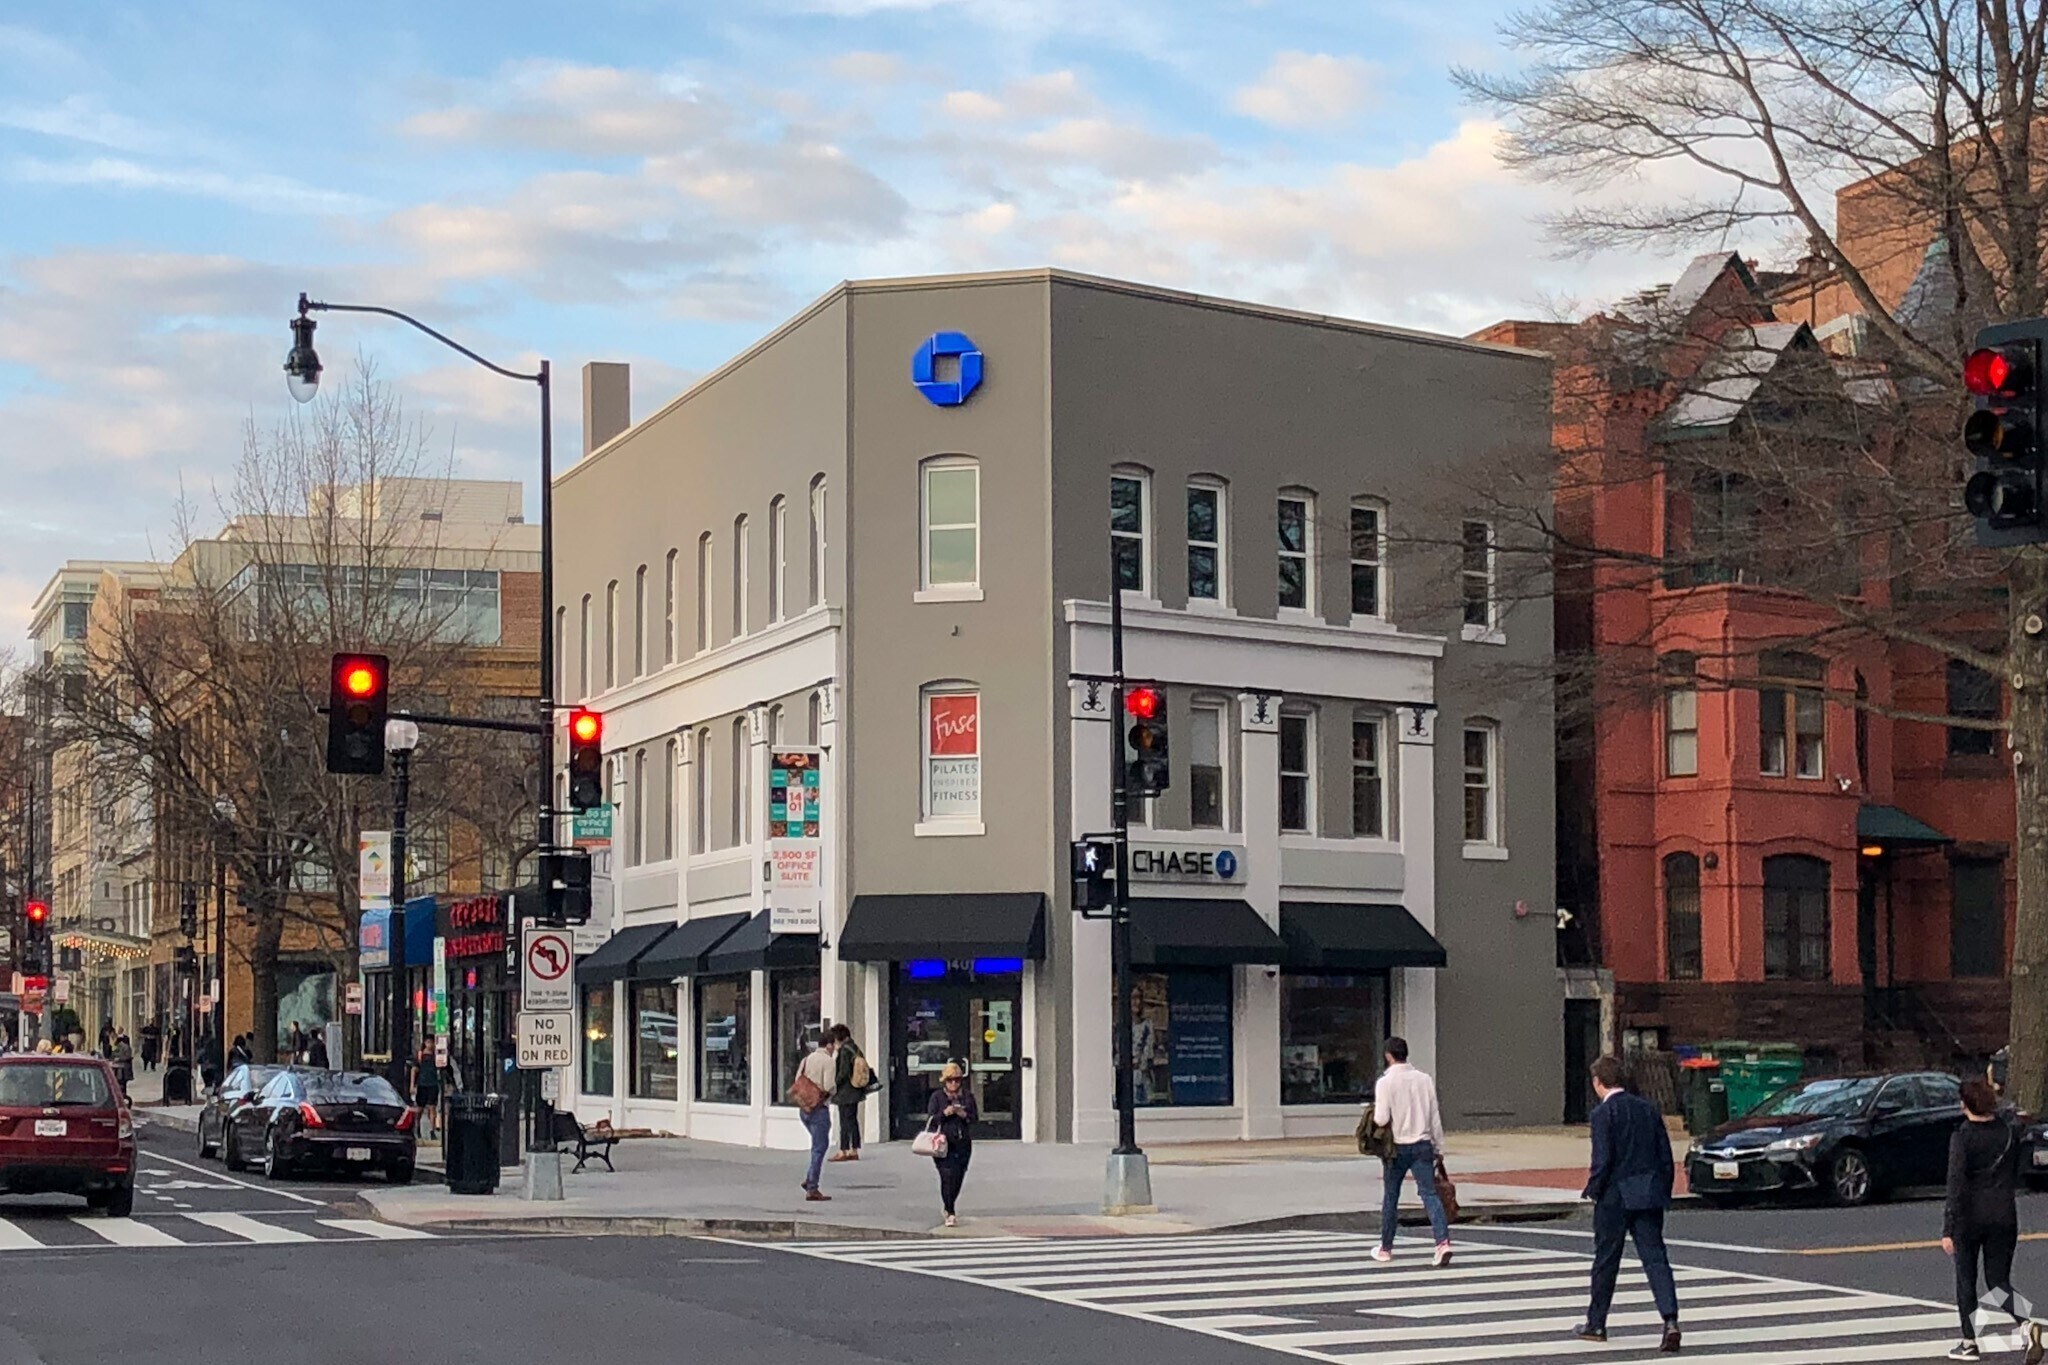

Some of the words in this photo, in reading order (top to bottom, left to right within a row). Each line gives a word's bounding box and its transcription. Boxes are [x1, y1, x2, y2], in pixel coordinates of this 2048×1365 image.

[934, 711, 976, 740] Fuse
[933, 764, 977, 774] PILATES
[789, 792, 801, 801] 14
[933, 791, 977, 801] FITNESS
[773, 851, 802, 861] 2,500
[805, 851, 817, 859] SF
[777, 862, 813, 870] OFFICE
[1133, 850, 1214, 874] CHASE
[535, 1019, 554, 1029] NO
[529, 1034, 561, 1045] TURN
[522, 1050, 538, 1061] ON
[544, 1049, 568, 1060] RED
